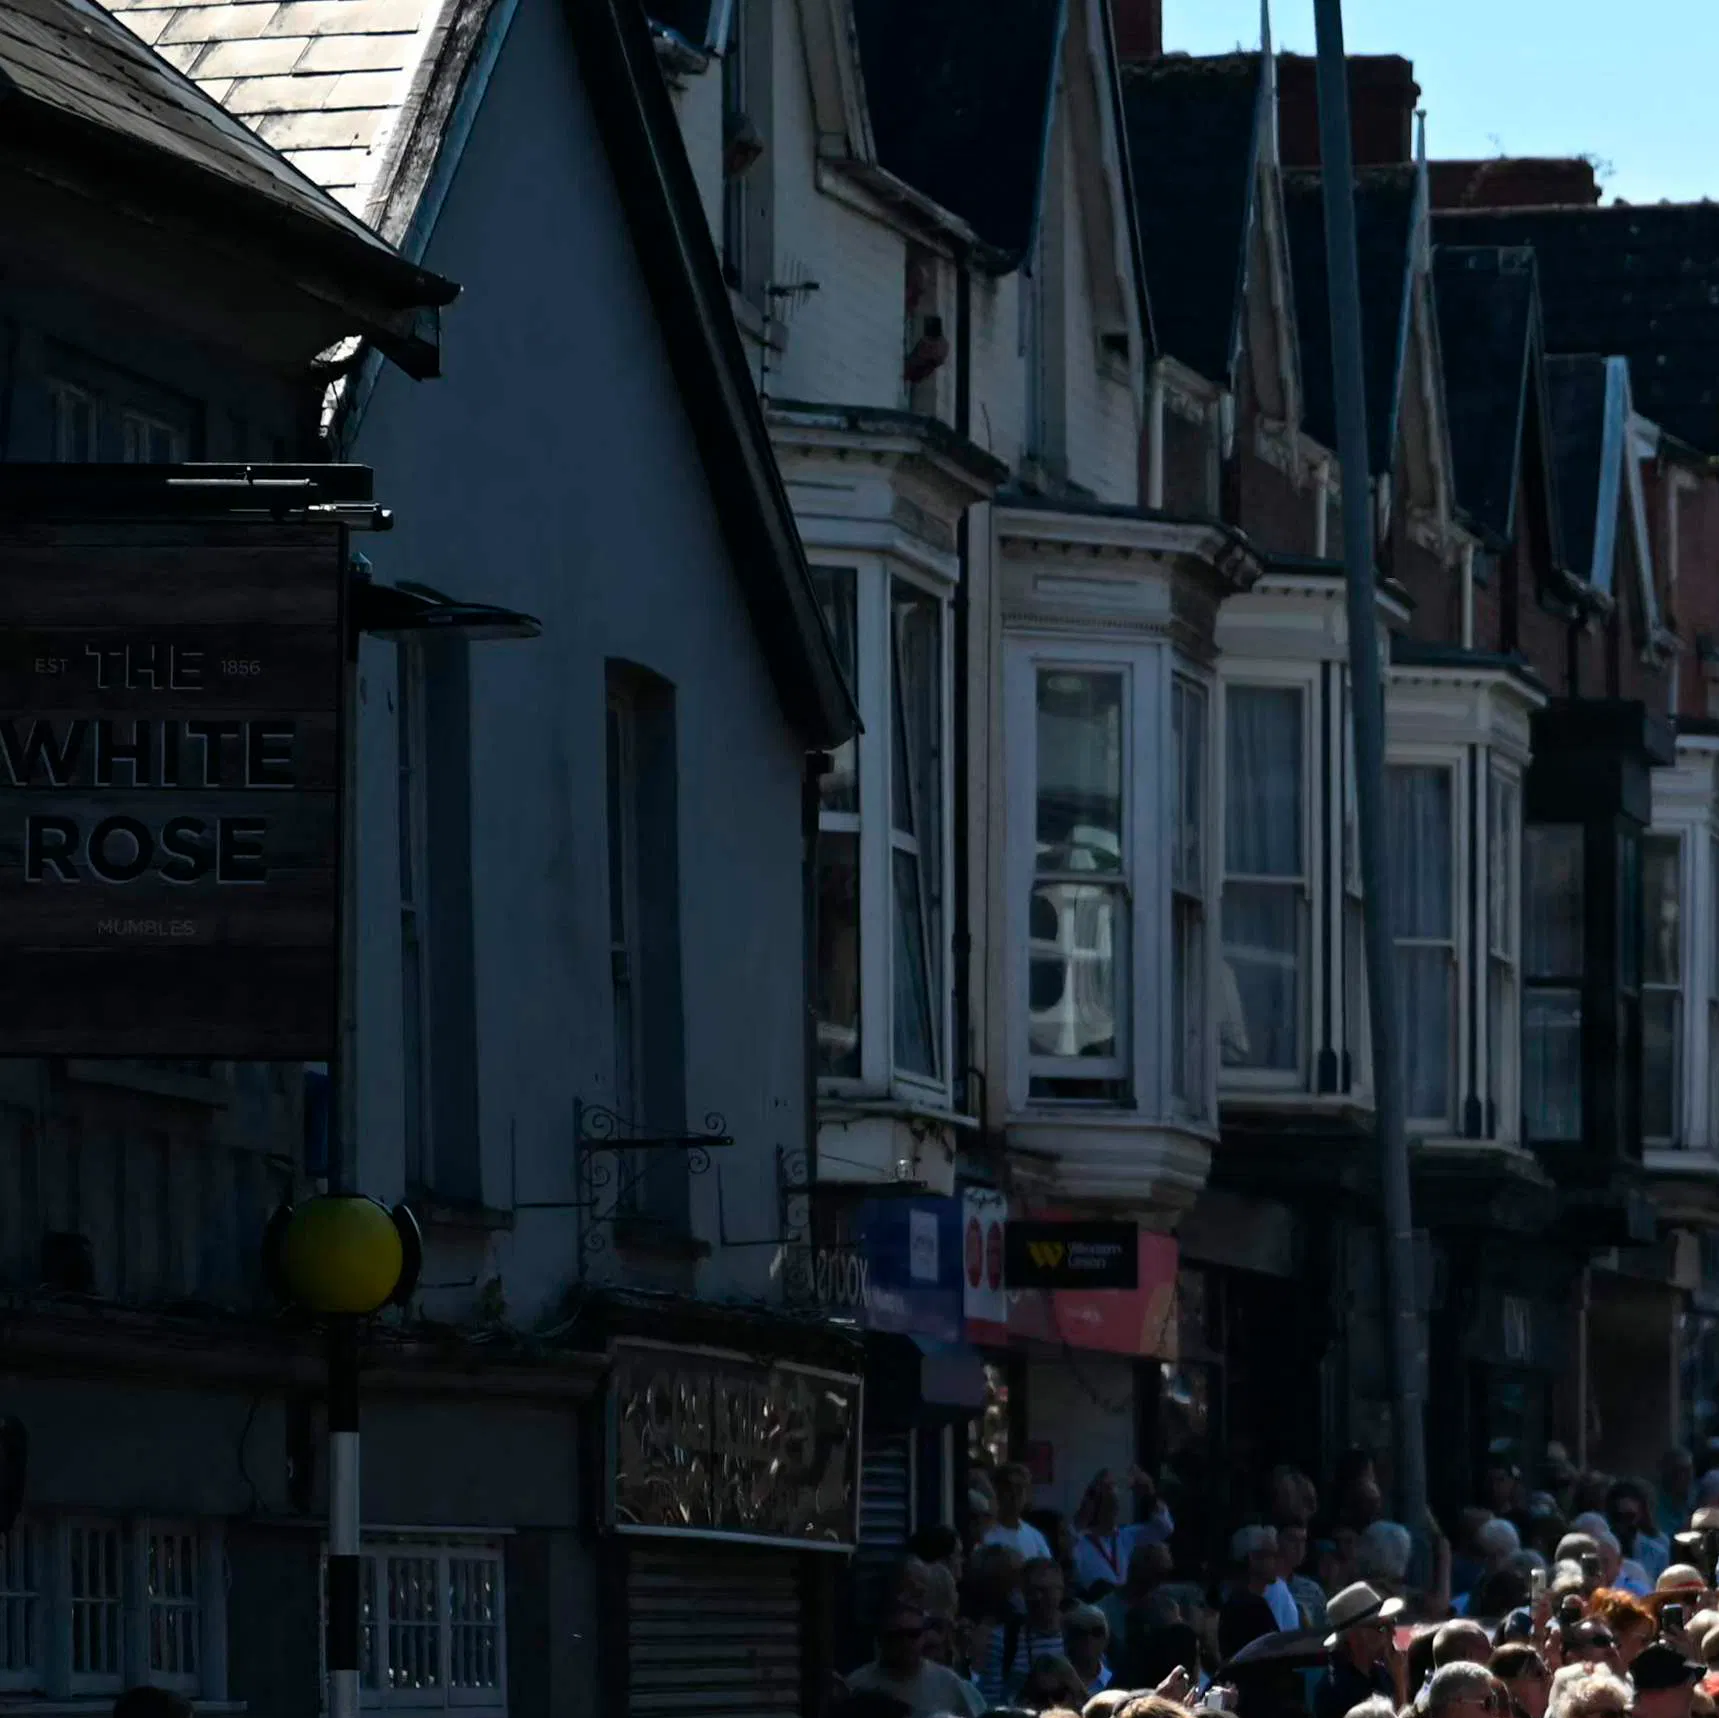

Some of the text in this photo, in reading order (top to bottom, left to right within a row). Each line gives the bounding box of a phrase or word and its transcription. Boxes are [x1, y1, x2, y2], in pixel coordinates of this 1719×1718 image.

[34, 658, 69, 675] EST
[84, 643, 206, 690] THE
[0, 719, 297, 788] WHITE
[25, 816, 268, 885] ROSE
[96, 919, 197, 938] MUMBLES
